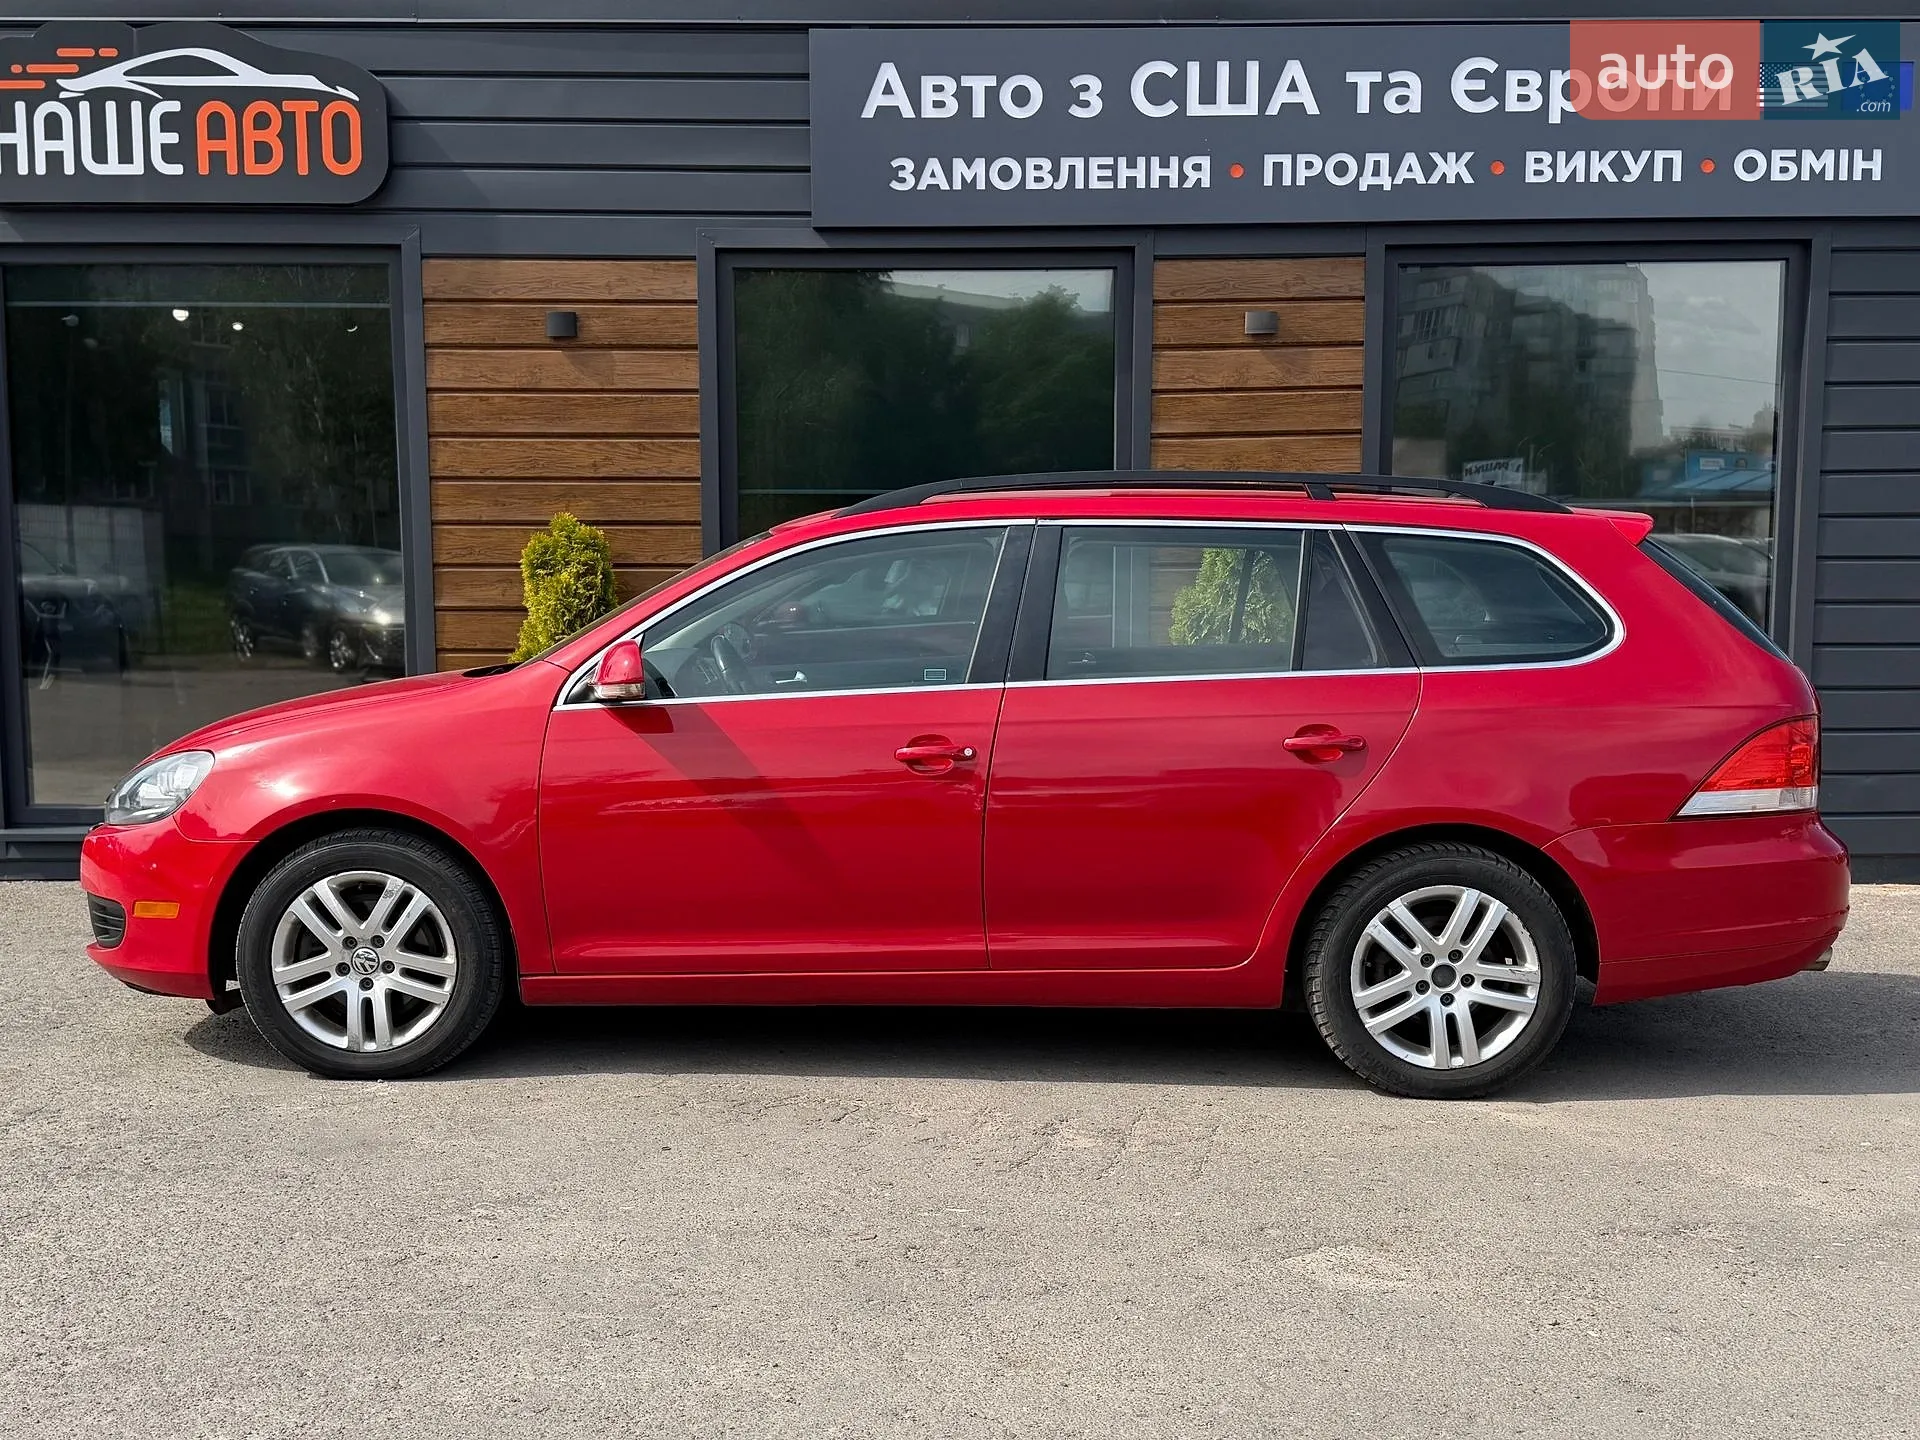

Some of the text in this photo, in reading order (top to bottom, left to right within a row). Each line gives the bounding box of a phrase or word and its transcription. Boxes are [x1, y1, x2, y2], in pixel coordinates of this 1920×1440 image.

[861, 56, 1733, 124] Авто з США та Європи
[0, 100, 363, 175] НАШЕ АВТО
[890, 149, 1882, 191] ЗАМОВЛЕННЯ ПРОДАЖ ВИКУП ОБМІН
